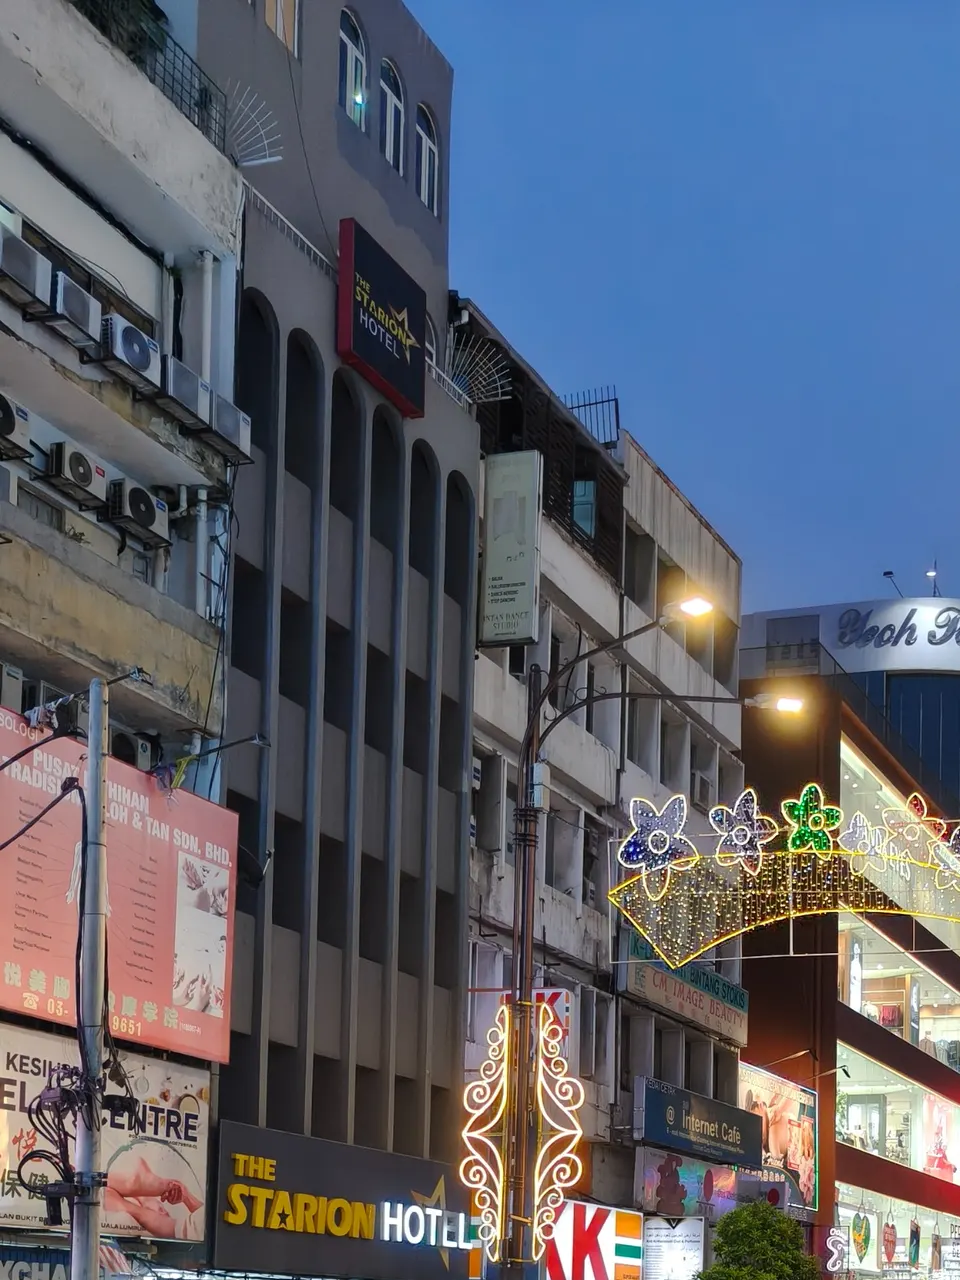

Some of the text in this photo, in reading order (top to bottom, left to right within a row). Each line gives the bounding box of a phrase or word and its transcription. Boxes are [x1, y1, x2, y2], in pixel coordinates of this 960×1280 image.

[355, 272, 371, 293] THE
[355, 286, 408, 345] STARION
[360, 307, 400, 359] HOTEL
[132, 811, 142, 830] &
[146, 816, 169, 842] TAN
[173, 828, 201, 856] SDN.
[205, 842, 232, 868] BHD.
[652, 971, 667, 992] CM
[673, 981, 704, 1011] IMAGE
[710, 1001, 744, 1028] BEAUTY
[112, 1015, 142, 1037] 9651
[682, 1110, 719, 1138] Internet
[232, 1153, 276, 1181] THE
[224, 1184, 472, 1249] STARION HOTEL
